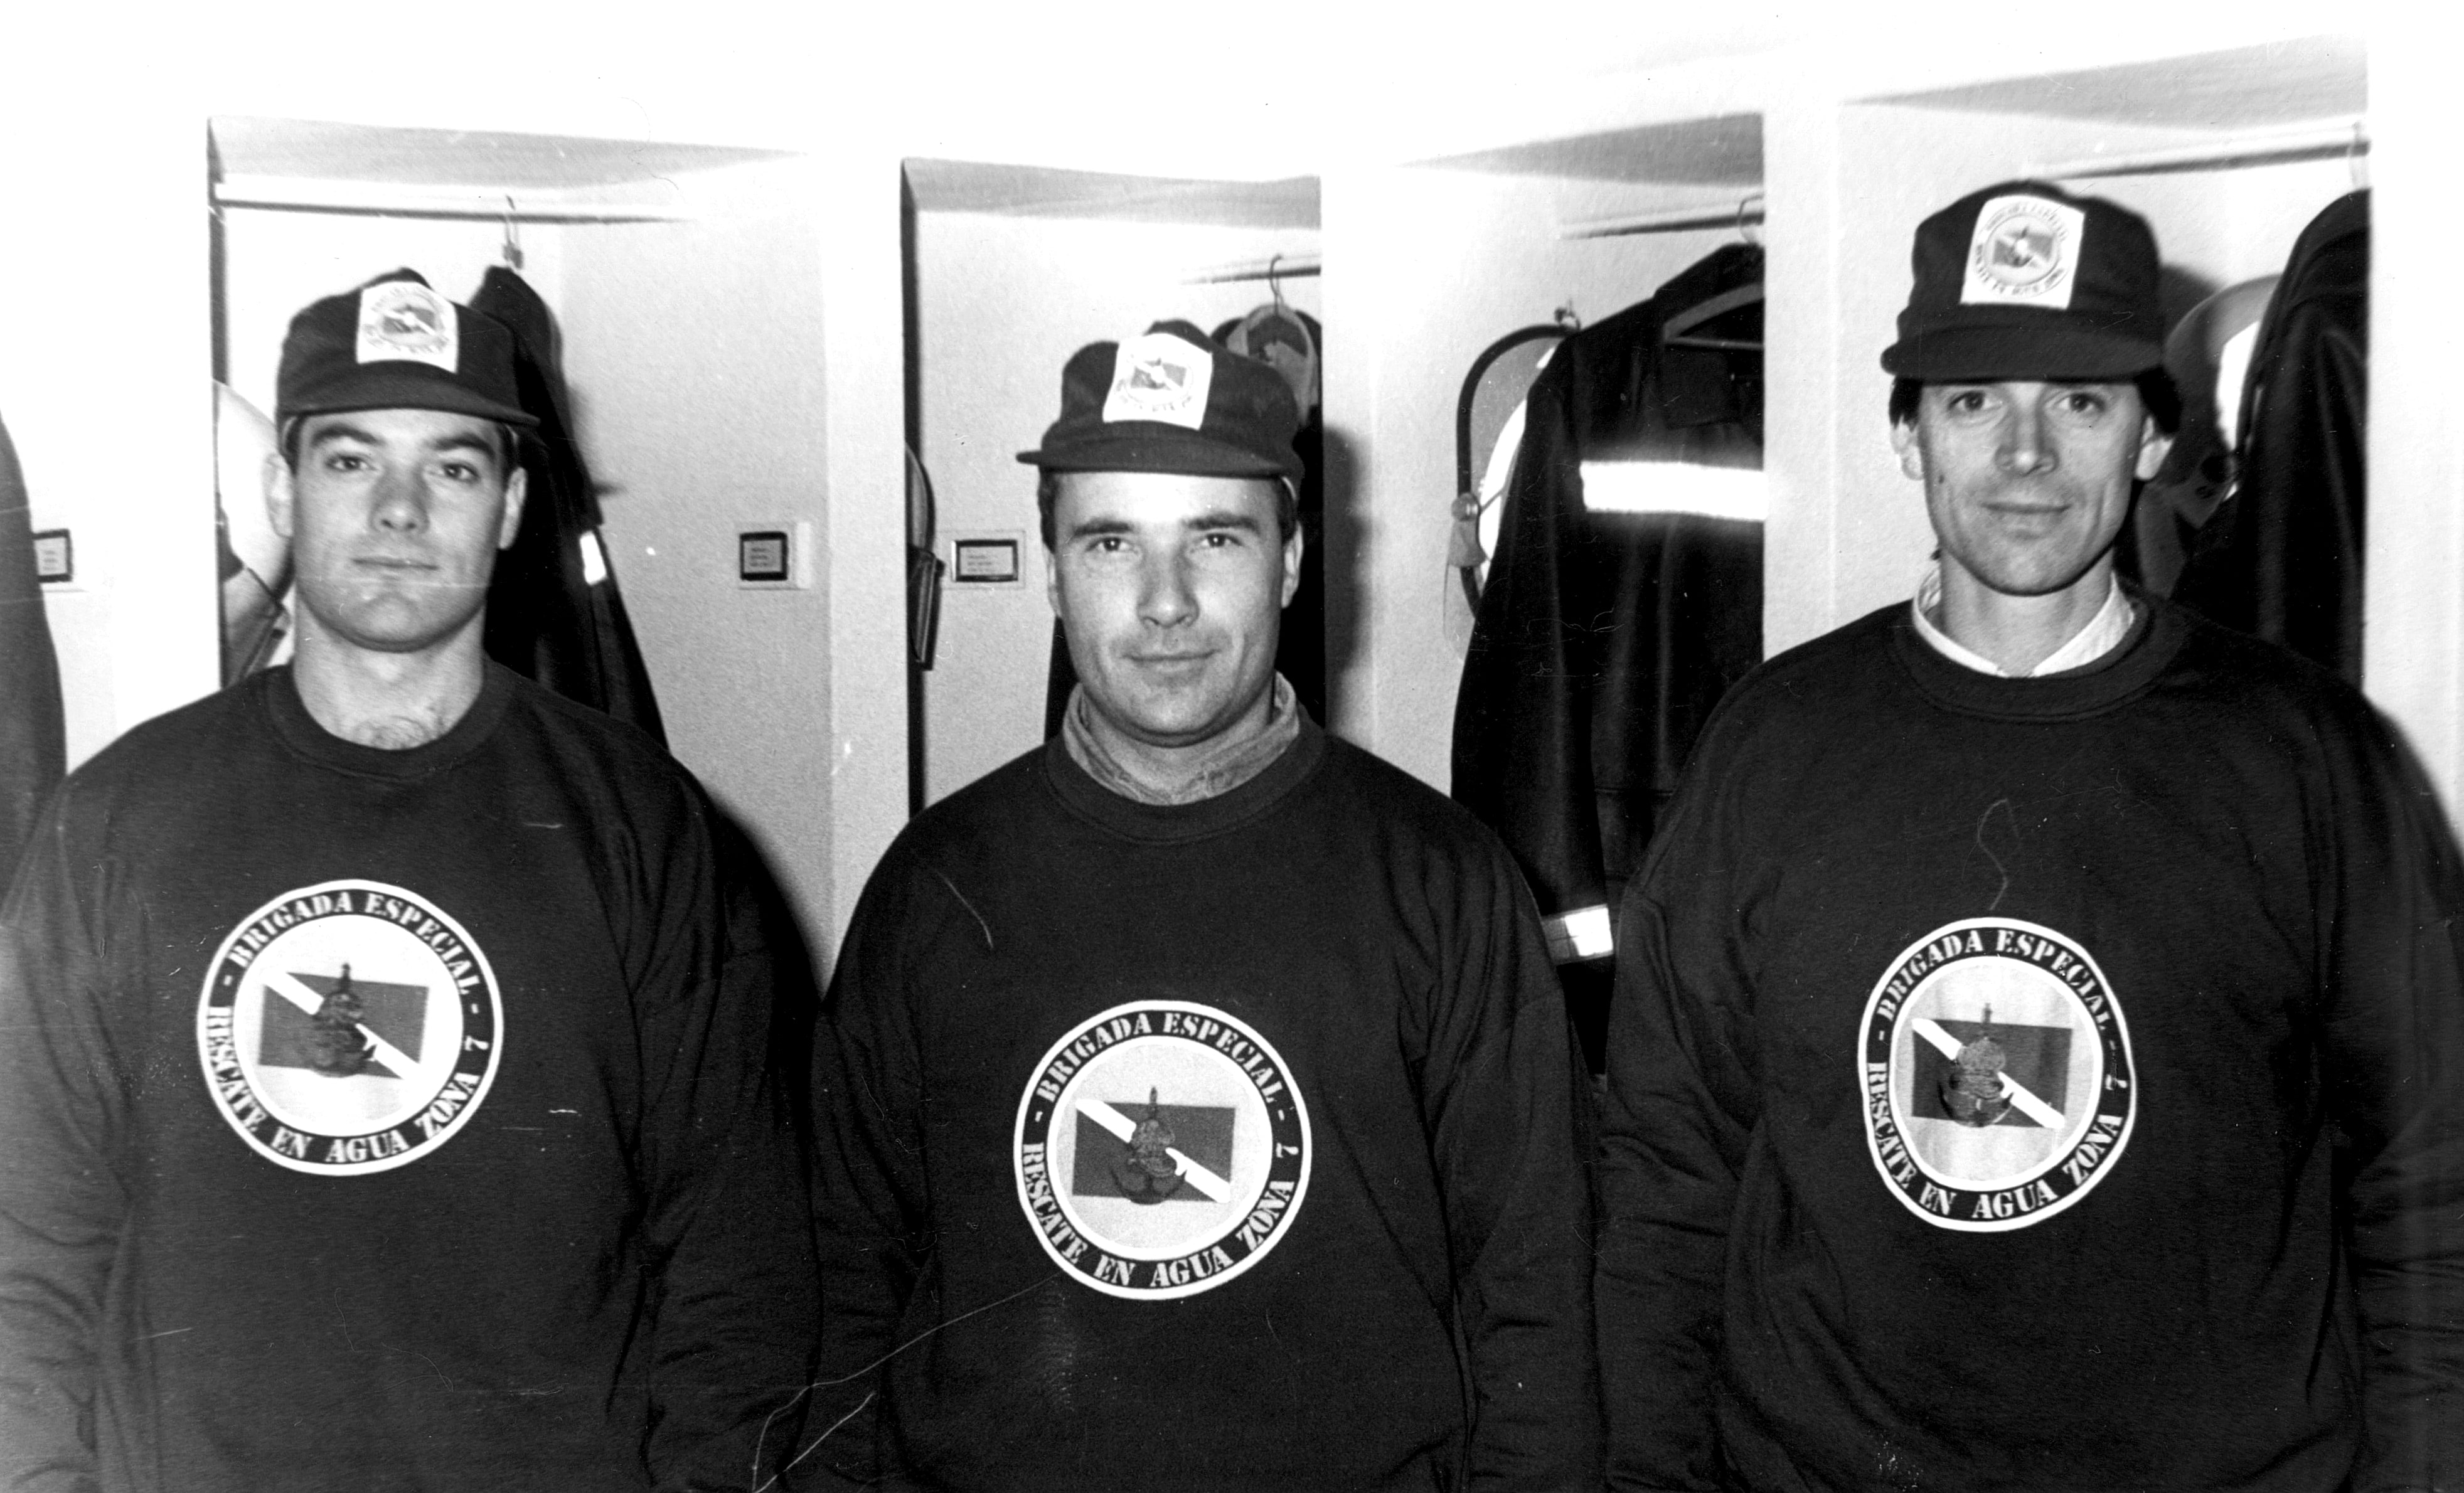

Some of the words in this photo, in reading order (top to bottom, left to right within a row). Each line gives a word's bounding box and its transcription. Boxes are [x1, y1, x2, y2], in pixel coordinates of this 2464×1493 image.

[228, 892, 352, 969] BRIGADA
[365, 893, 481, 996] ESPECIAL
[1877, 930, 1984, 1022] BRIGADA
[1995, 929, 2109, 1031] ESPECIAL
[207, 1006, 267, 1132] RESCATE
[270, 1126, 312, 1158] EN
[326, 1130, 410, 1162] AGUA
[414, 1071, 481, 1140] ZONA
[465, 1036, 489, 1051] 7
[1036, 1012, 1152, 1103] BRIGADA
[1163, 1012, 1283, 1103] ESPECIAL
[1868, 1063, 1917, 1189] RESCATE
[1919, 1181, 1956, 1215] EN
[1971, 1179, 2058, 1218] AGUA
[2062, 1114, 2123, 1186] ZONA
[1023, 1142, 1088, 1265] RESCATE
[1093, 1254, 1136, 1287] EN
[1149, 1246, 1234, 1287] AGUA
[1235, 1181, 1295, 1252] ZONA
[1276, 1142, 1299, 1159] 7
